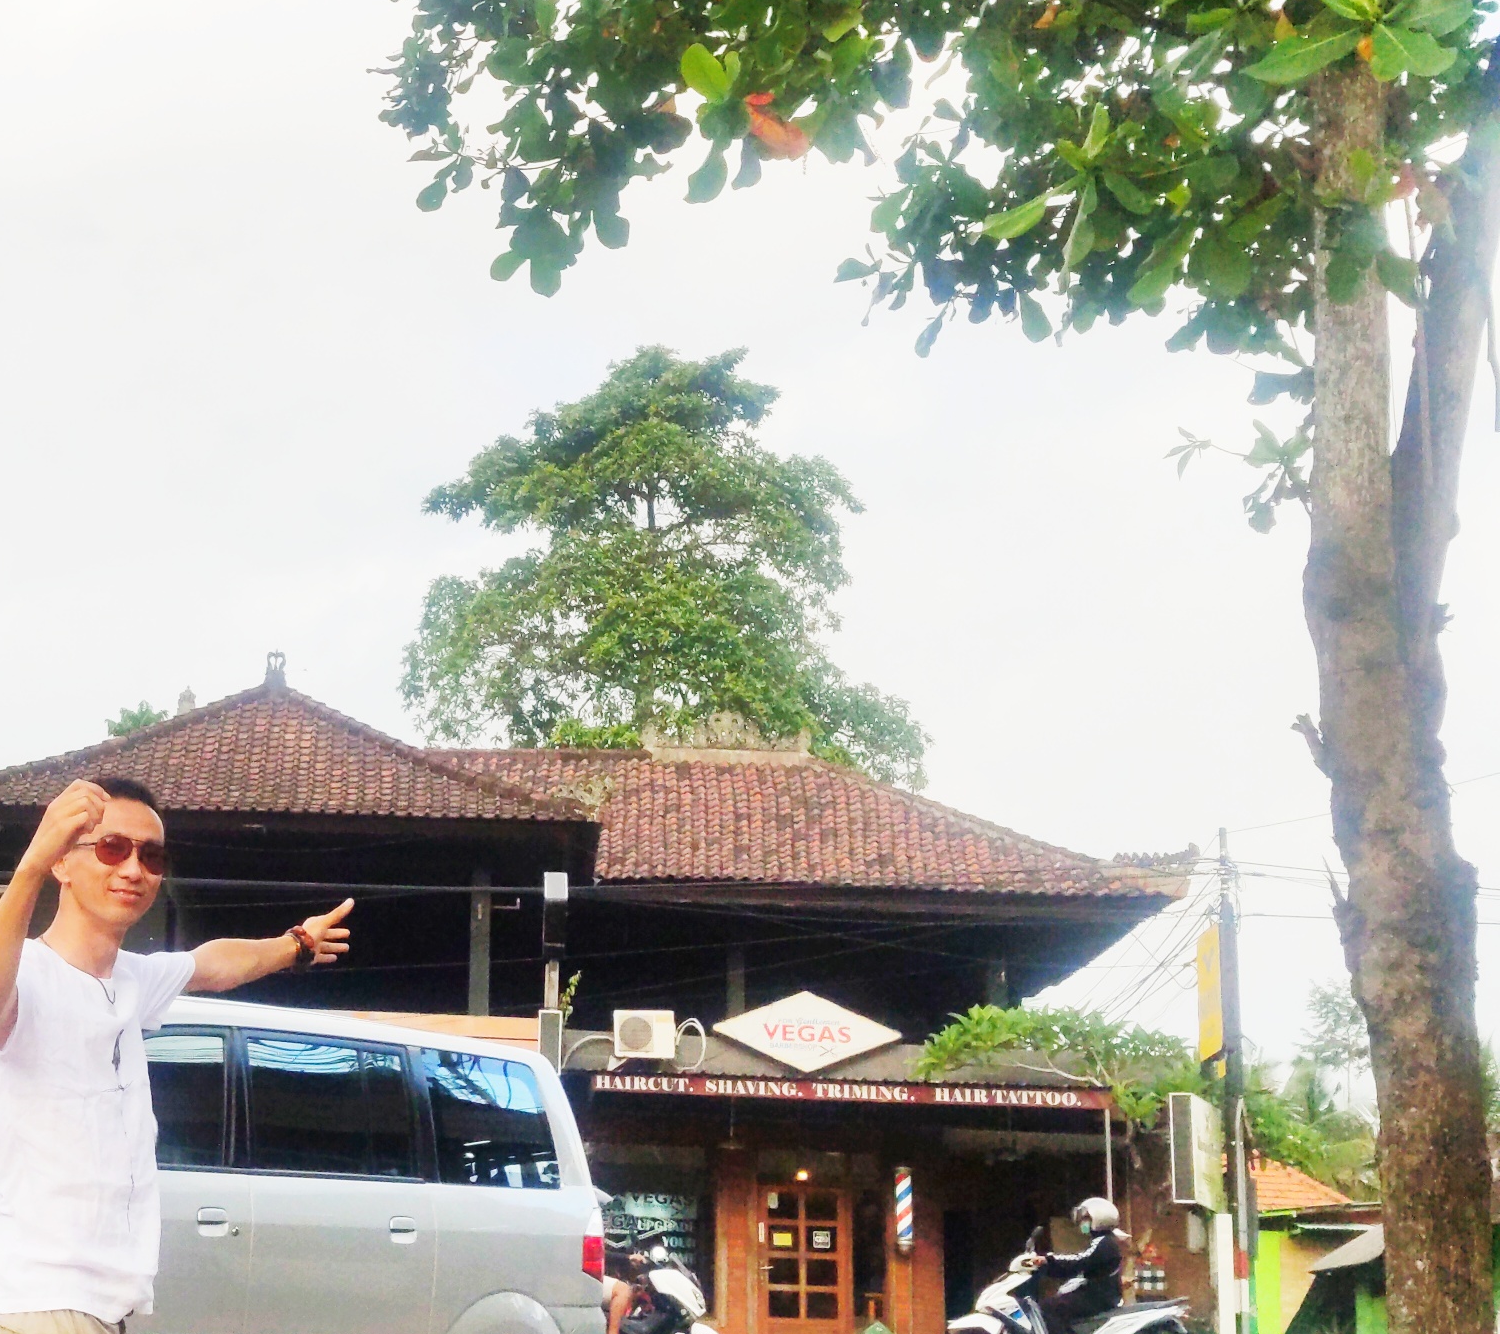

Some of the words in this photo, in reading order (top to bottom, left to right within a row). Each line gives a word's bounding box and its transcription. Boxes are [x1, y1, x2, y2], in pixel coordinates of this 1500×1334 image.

[763, 1023, 851, 1044] VEGAS
[595, 1075, 694, 1093] HAIRCUT.
[705, 1079, 803, 1097] SHAVING.
[812, 1082, 915, 1102] TRIMING.
[935, 1088, 988, 1104] HAIR
[991, 1090, 1082, 1107] TATTOO.
